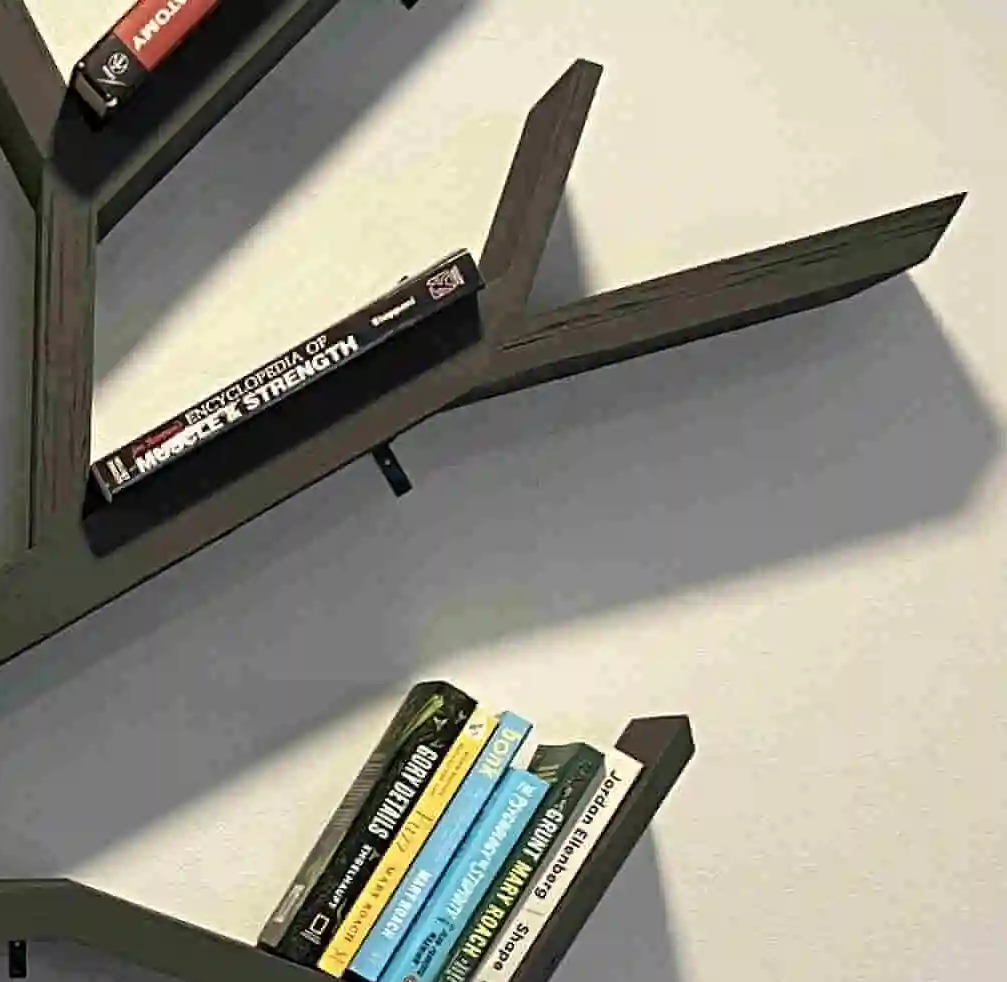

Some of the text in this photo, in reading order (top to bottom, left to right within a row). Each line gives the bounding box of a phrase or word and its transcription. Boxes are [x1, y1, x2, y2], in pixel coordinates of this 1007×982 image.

[183, 347, 304, 426] ENCYCLOPEDIA
[239, 332, 360, 412] STRENGTH
[365, 741, 440, 841] GORY DETAILS
[476, 724, 523, 782] bonk
[531, 768, 625, 902] Jordan Ellenberg
[459, 804, 566, 960] GRUNT MARY ROACH
[489, 920, 531, 974] Shape
